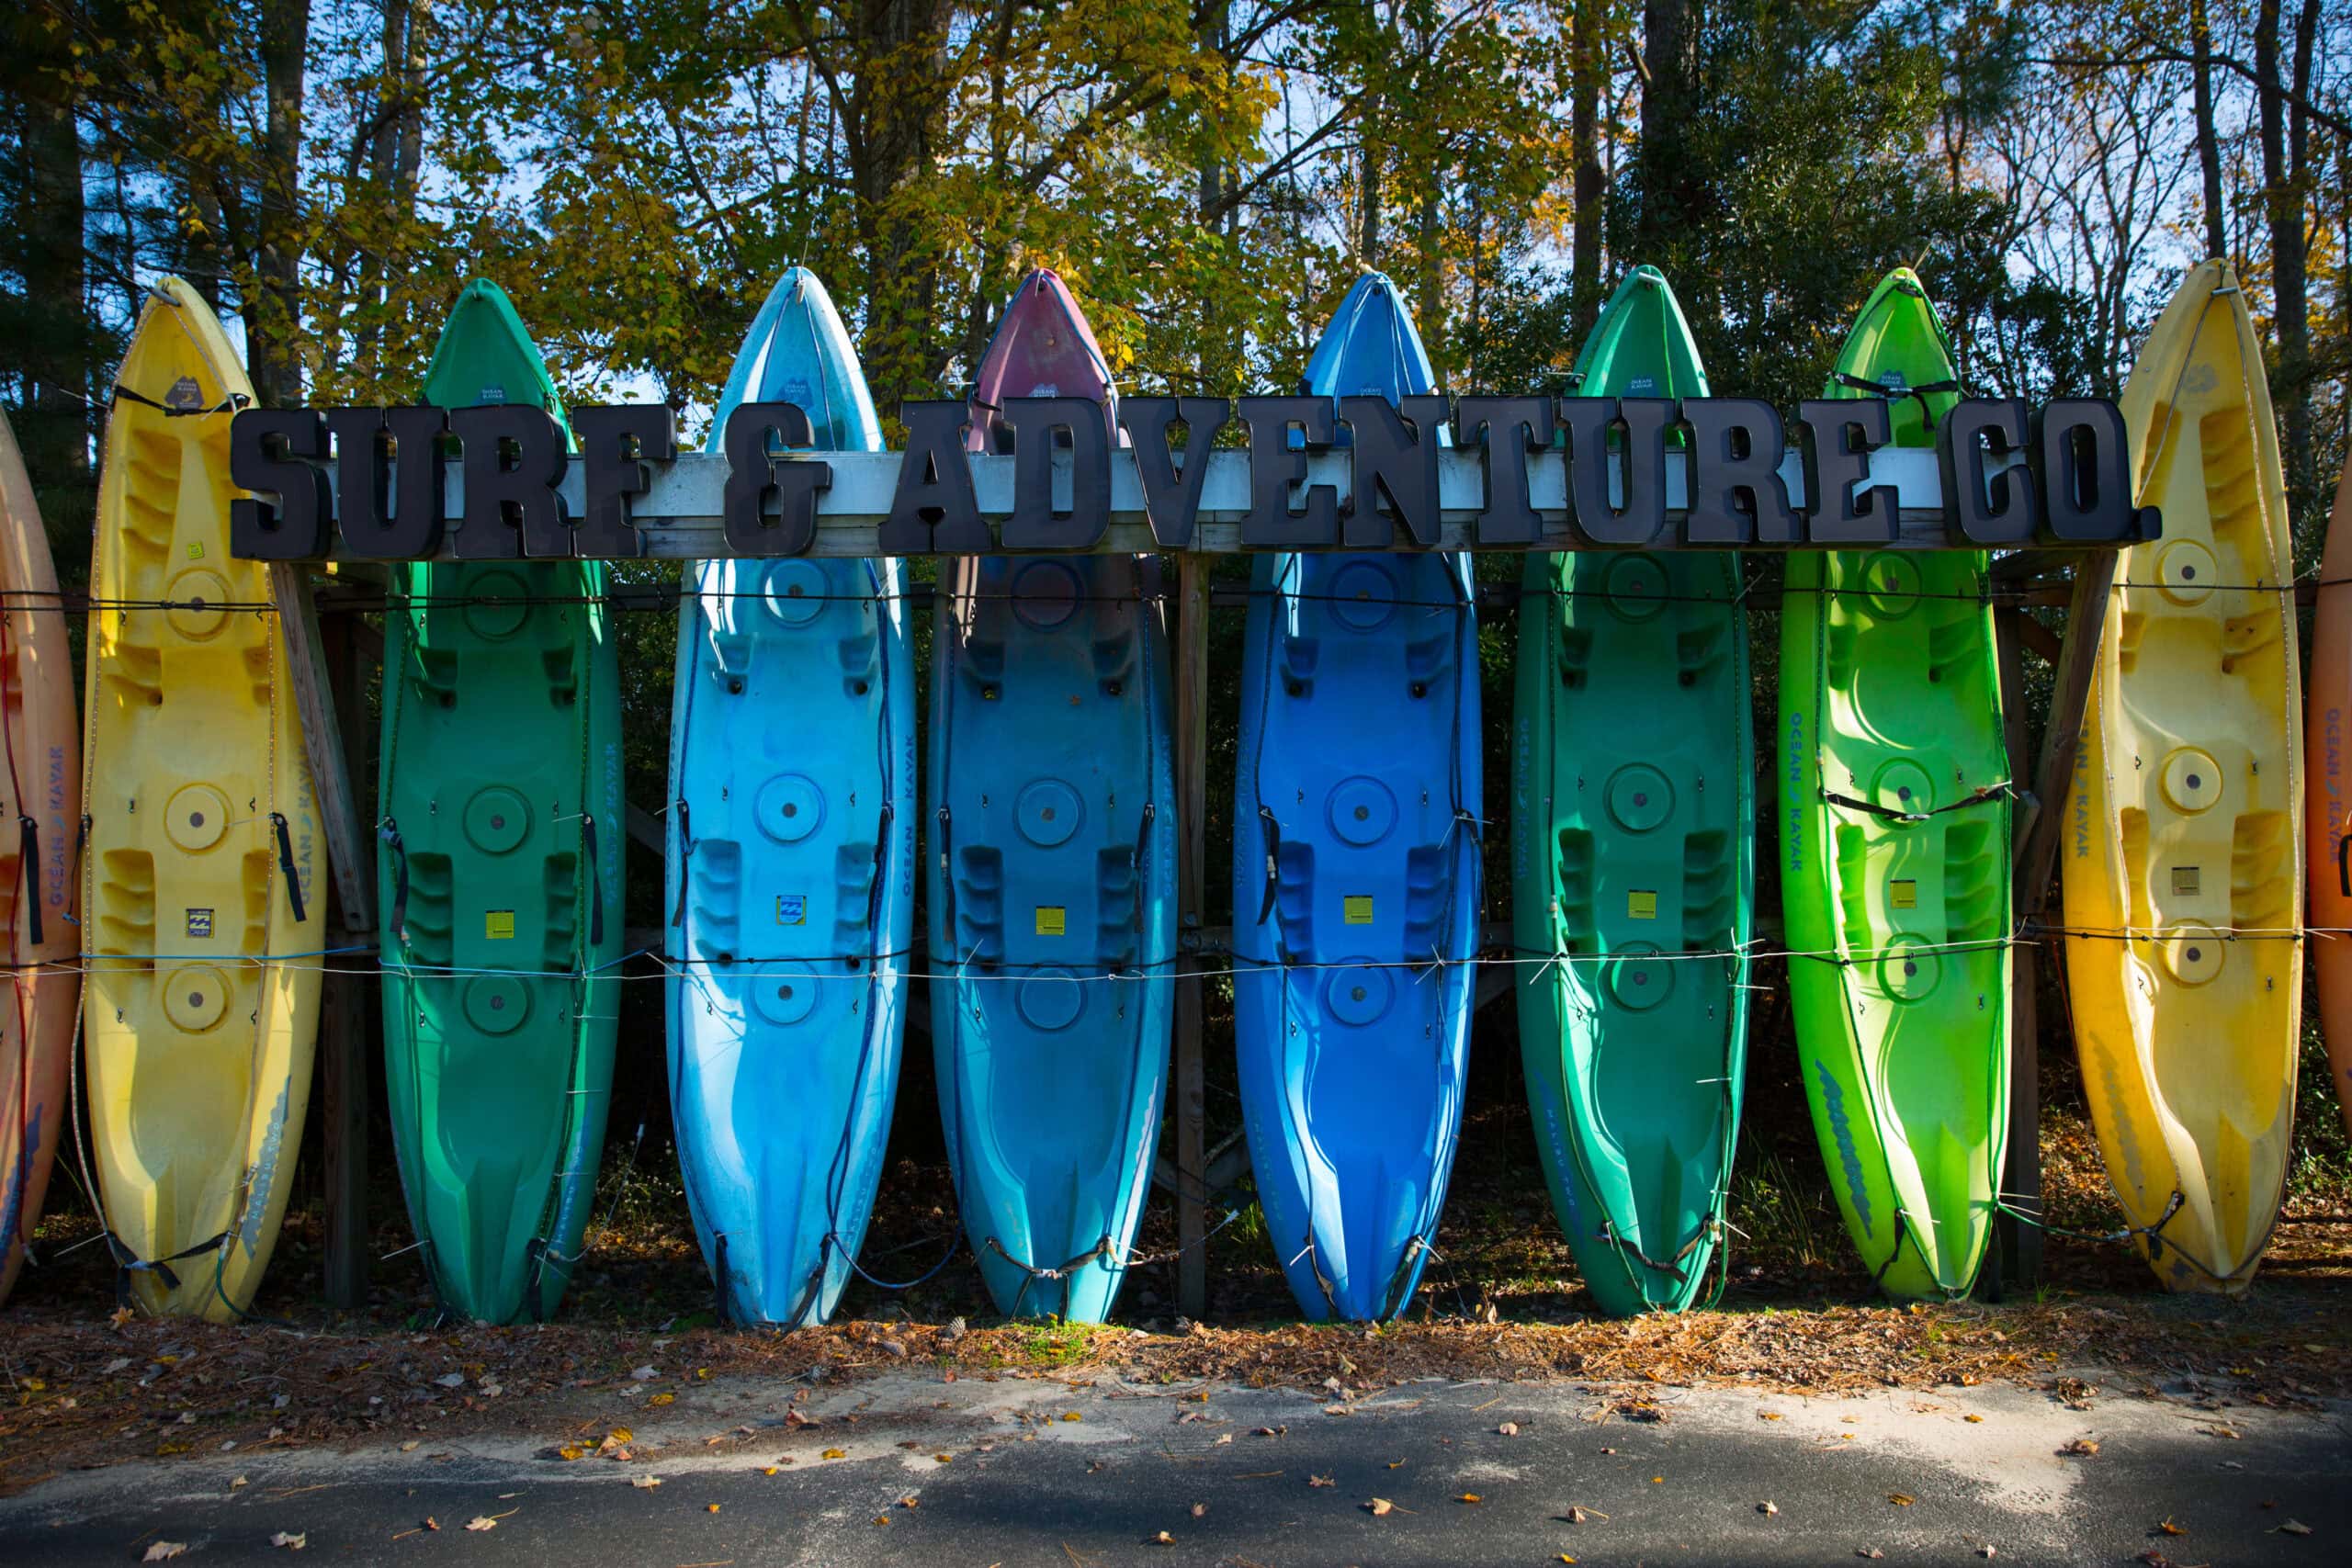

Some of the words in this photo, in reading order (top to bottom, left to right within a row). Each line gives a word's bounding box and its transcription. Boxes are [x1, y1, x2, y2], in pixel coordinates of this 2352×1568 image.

[230, 404, 677, 558] SURF
[723, 400, 832, 554] &
[878, 396, 1900, 553] ADVENTURE
[1939, 397, 2163, 546] CO.
[903, 735, 914, 800] KAYAK
[1790, 711, 1804, 783] OCEAN
[2324, 707, 2341, 777] OCEAN
[50, 745, 65, 810] KAYAK
[903, 825, 914, 897] OCEAN
[1791, 807, 1804, 873] KAYAK
[2075, 795, 2089, 861] KAYAK
[2327, 800, 2343, 865] KAYAK
[51, 836, 66, 907] OCEAN
[299, 833, 313, 905] OCEAN
